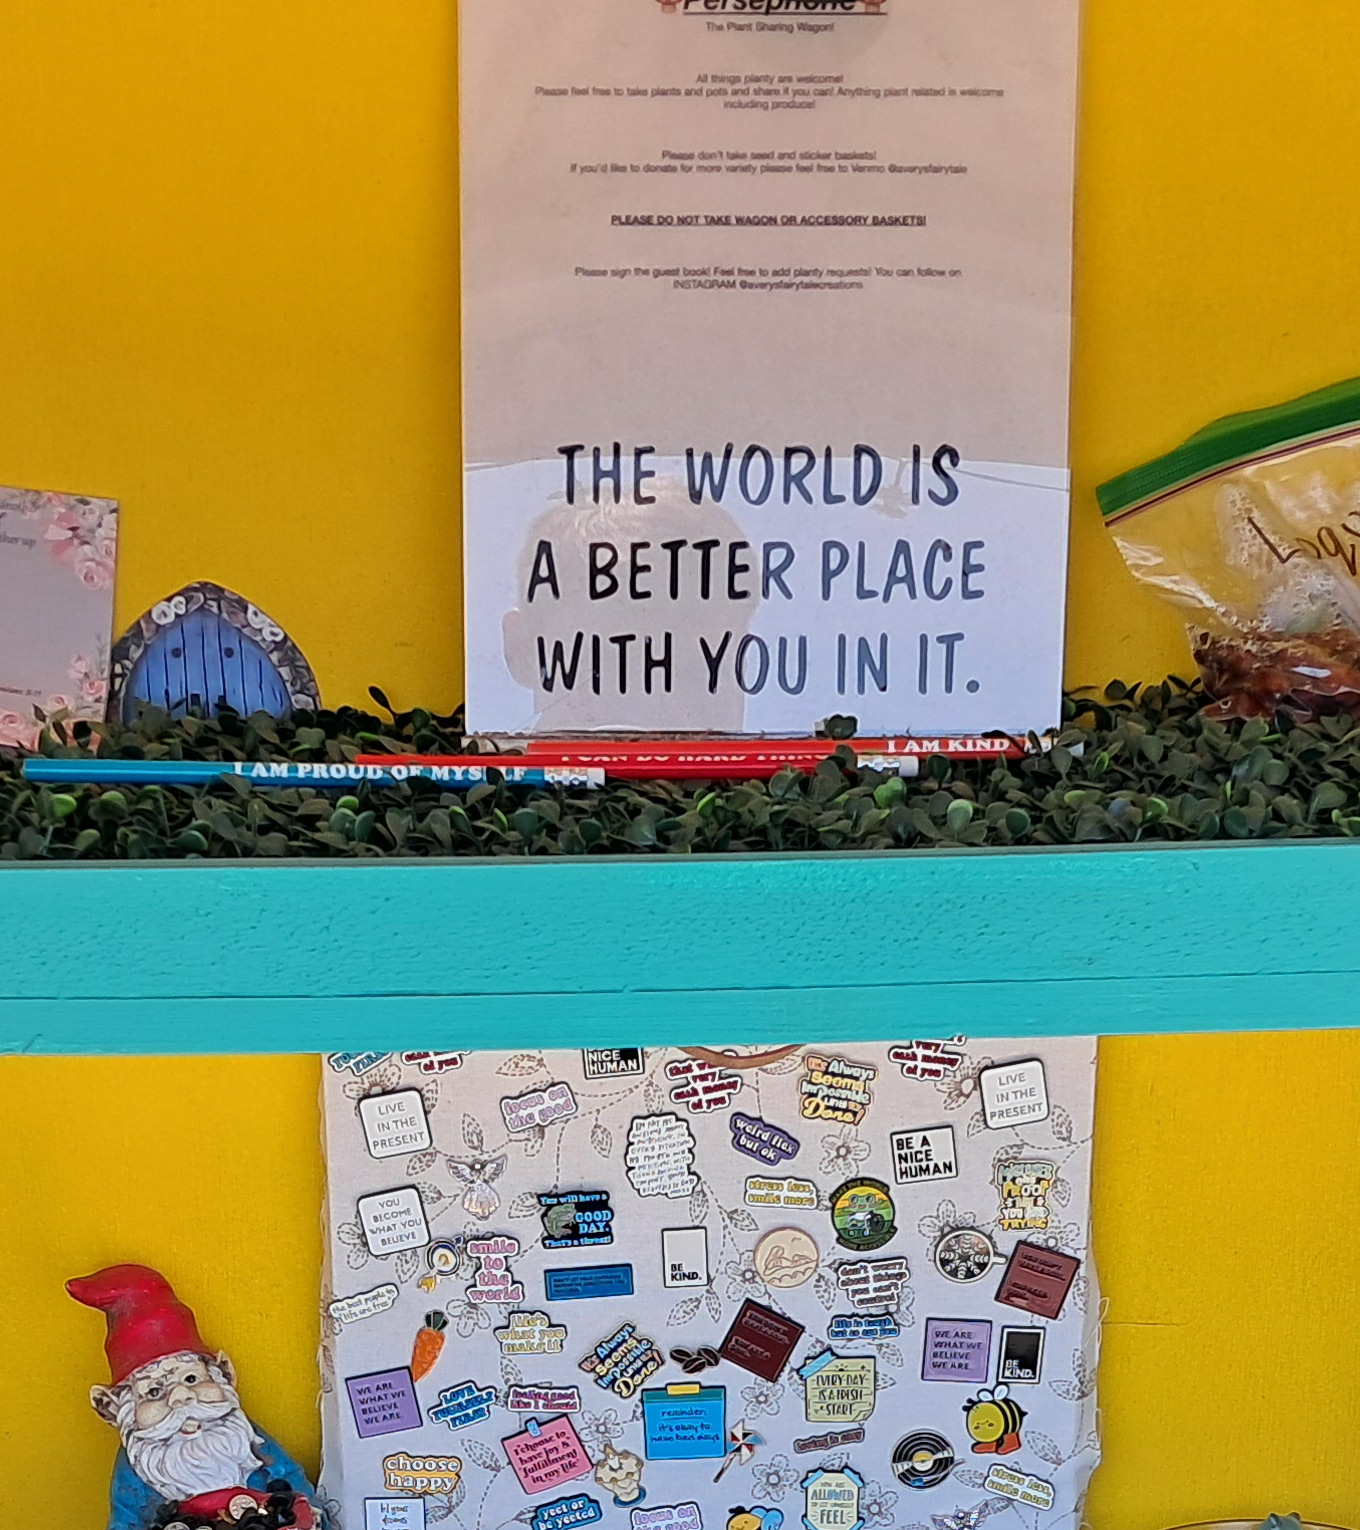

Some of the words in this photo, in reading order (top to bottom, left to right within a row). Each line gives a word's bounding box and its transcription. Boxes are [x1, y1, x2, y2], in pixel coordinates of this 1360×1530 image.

[611, 215, 653, 225] PLEASE
[657, 215, 673, 225] DO
[677, 215, 699, 225] NOT
[704, 215, 730, 225] TAKE
[735, 215, 777, 225] WAGON
[781, 215, 797, 225] OR
[800, 215, 869, 225] ACCESSORY
[872, 215, 926, 225] BASKETS!
[557, 443, 656, 505] THE
[686, 442, 883, 506] WORLD
[912, 444, 959, 506] IS
[528, 540, 560, 603] A
[588, 539, 796, 601] BETTER
[821, 539, 986, 603] PLACE
[538, 632, 673, 695] WITH
[699, 631, 807, 695] YOU
[838, 632, 888, 695] IN
[918, 632, 981, 695] IT.
[887, 739, 896, 753] I
[902, 739, 940, 752] AM
[947, 738, 1010, 752] KIND
[232, 762, 243, 776] I
[250, 762, 289, 778] AM
[296, 763, 383, 780] PROUD
[390, 765, 422, 781] OF
[430, 765, 528, 781] MYSLF
[590, 1050, 621, 1062] NICE
[590, 1059, 637, 1075] HUMAN
[378, 1102, 406, 1116] LIVE
[377, 1121, 392, 1133] IN
[395, 1117, 418, 1131] THE
[736, 1119, 771, 1141] weird
[372, 1131, 424, 1150] PRESENT
[740, 1135, 759, 1152] but
[760, 1148, 777, 1161] ok
[895, 1136, 914, 1150] BE
[920, 1134, 931, 1148] A
[897, 1149, 933, 1165] NICE
[899, 1161, 953, 1180] HUMAN
[378, 1199, 400, 1209] YOU
[373, 1208, 412, 1223] BECOME
[574, 1211, 612, 1222] GOOD
[369, 1222, 397, 1235] WHAT
[400, 1218, 422, 1229] YOU
[579, 1223, 610, 1233] DAY.
[380, 1232, 417, 1246] BELIEVE
[470, 1238, 516, 1254] smile
[484, 1255, 504, 1271] to
[670, 1263, 683, 1272] BE
[478, 1272, 509, 1286] the
[670, 1272, 703, 1282] KIND.
[470, 1285, 521, 1302] world
[934, 1330, 951, 1339] WE
[954, 1331, 973, 1339] ARE
[933, 1341, 964, 1350] WHAT
[966, 1341, 983, 1350] WE
[932, 1351, 970, 1360] BELIEVE
[1005, 1359, 1019, 1368] BE
[932, 1361, 949, 1370] WE
[1003, 1368, 1035, 1379] KIND.
[385, 1456, 459, 1472] choose
[388, 1473, 457, 1491] happy
[542, 1504, 569, 1520] yeet
[570, 1500, 585, 1510] or
